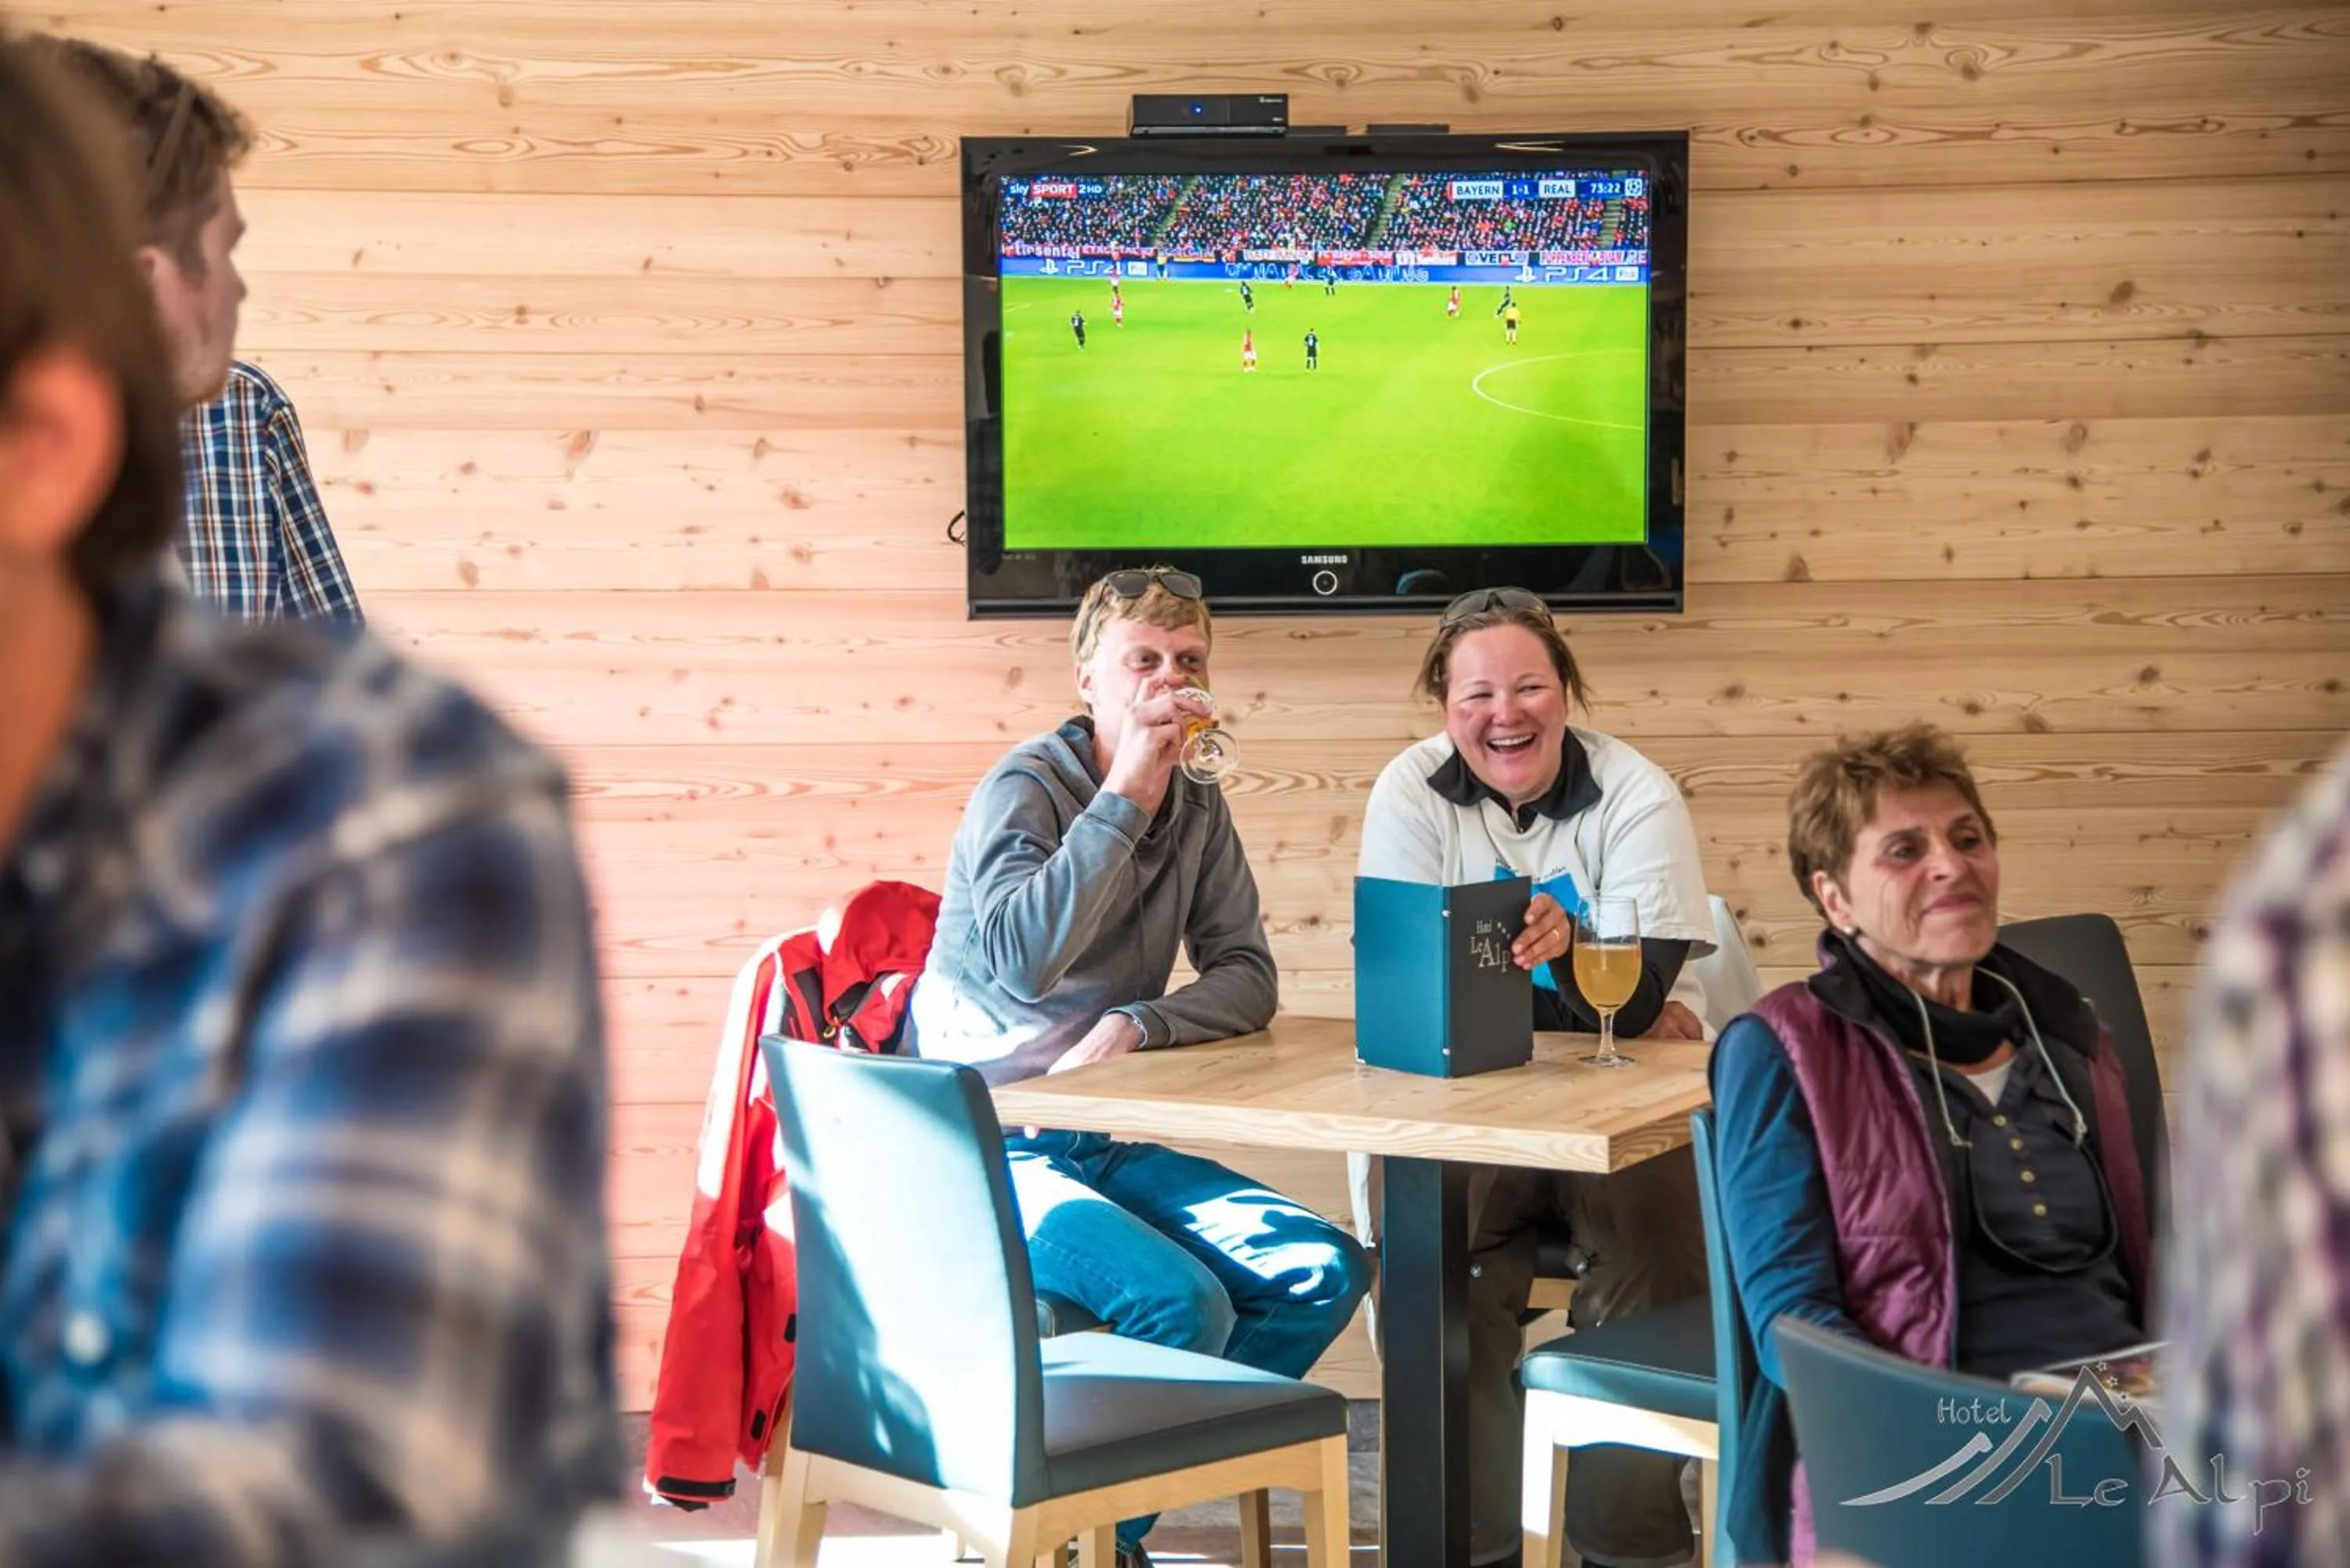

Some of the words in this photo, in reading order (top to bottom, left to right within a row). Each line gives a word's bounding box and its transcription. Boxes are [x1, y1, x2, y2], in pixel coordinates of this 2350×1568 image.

[1010, 183, 1029, 195] sky
[1033, 184, 1073, 194] SPORT
[1079, 184, 1086, 193] 2
[1087, 185, 1102, 193] HD
[1456, 185, 1500, 195] BAYERN
[1544, 184, 1571, 194] REAL
[1066, 259, 1121, 275] PS4
[1546, 266, 1609, 282] PS4
[1301, 555, 1348, 564] SAMSUNG
[1479, 937, 1511, 973] Alp
